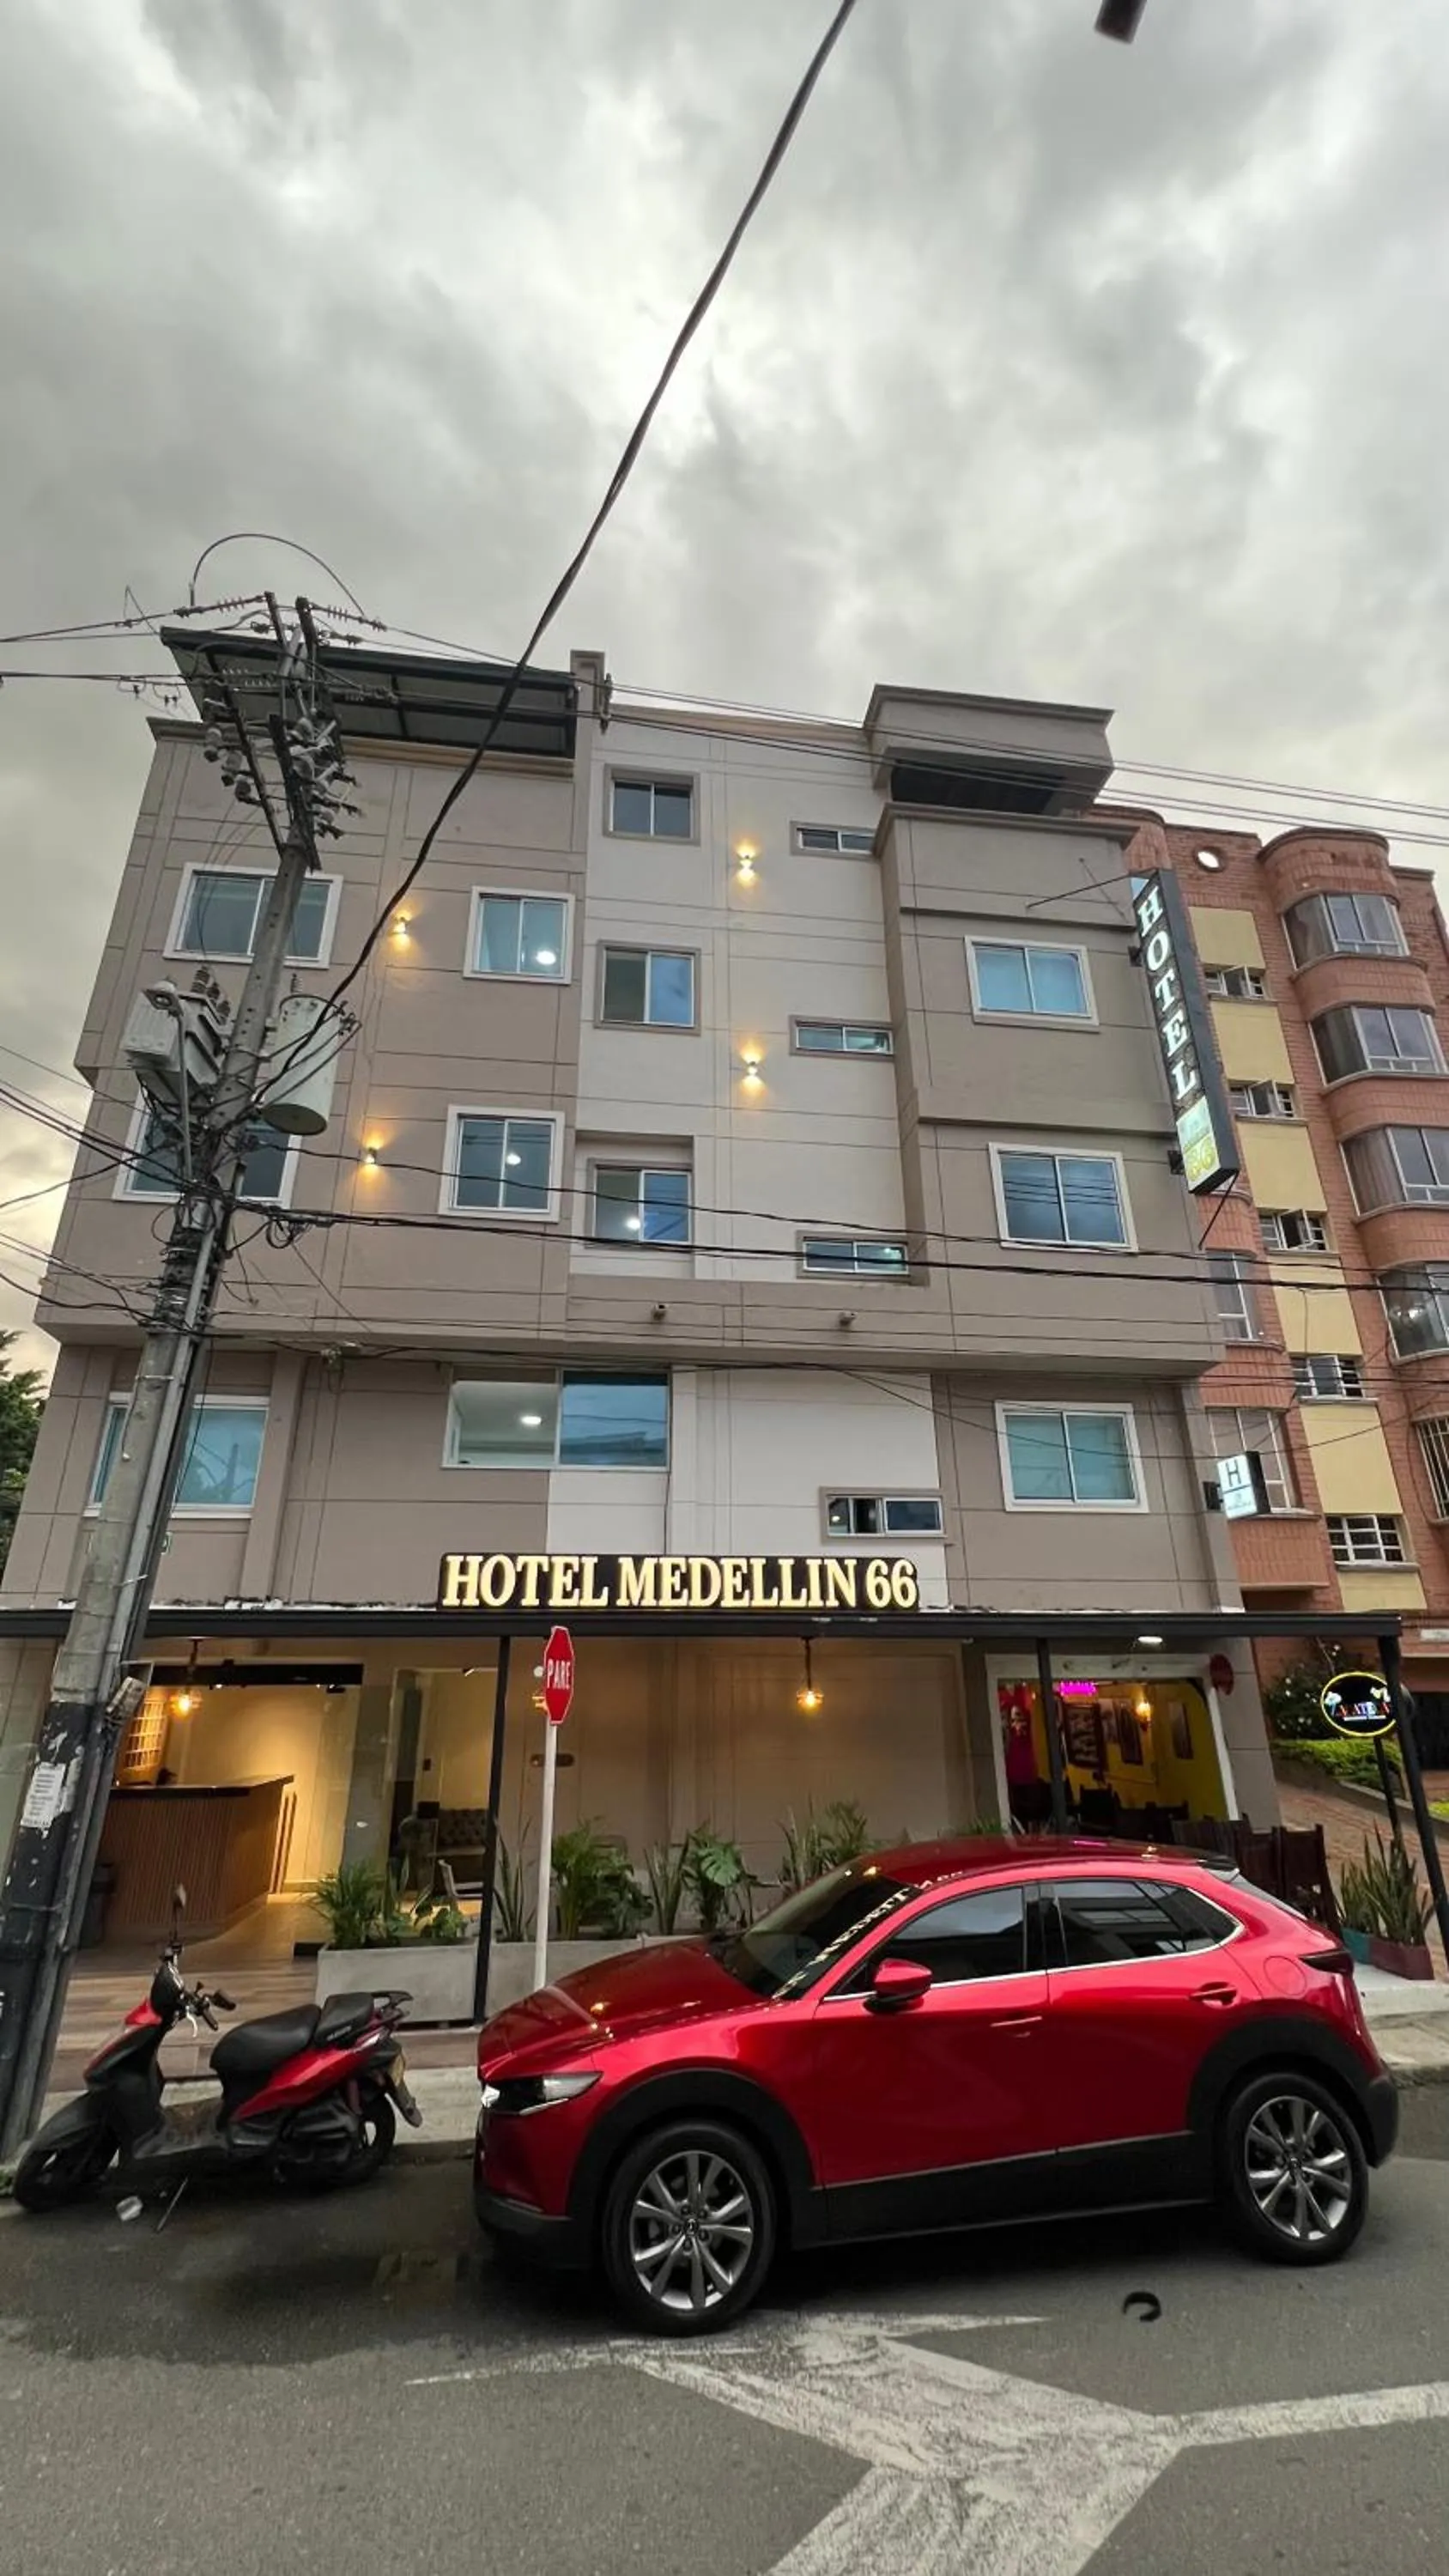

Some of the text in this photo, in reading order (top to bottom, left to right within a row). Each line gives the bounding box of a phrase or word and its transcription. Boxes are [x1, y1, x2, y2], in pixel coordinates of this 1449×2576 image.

[1137, 884, 1197, 1100] HOTEL
[1225, 1459, 1242, 1487] H
[443, 1554, 918, 1608] HOTEL MEDELLIN 66
[546, 1657, 571, 1690] PARE
